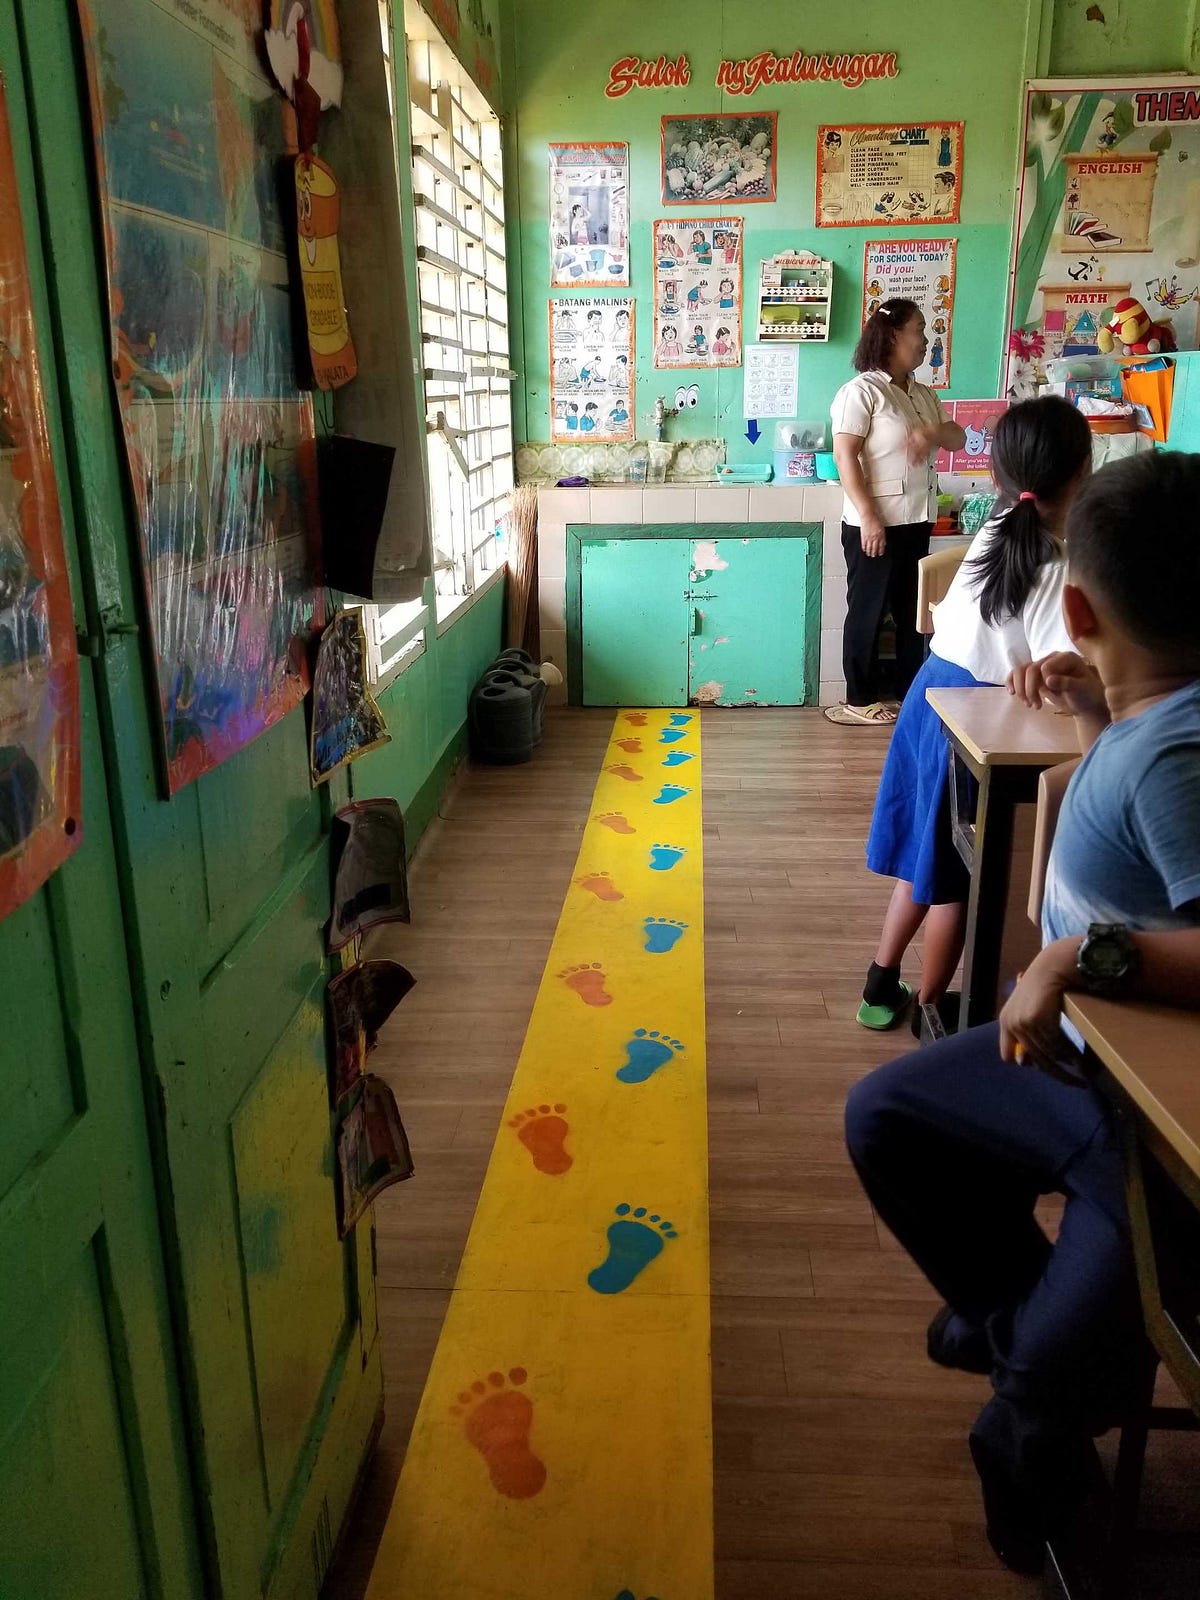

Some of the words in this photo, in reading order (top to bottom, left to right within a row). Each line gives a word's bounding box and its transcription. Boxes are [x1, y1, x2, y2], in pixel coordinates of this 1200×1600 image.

[605, 54, 691, 99] Sulok
[900, 128, 927, 139] CHART
[1078, 163, 1143, 175] ENGLISH
[878, 244, 896, 254] ARE
[898, 243, 916, 254] YOU
[917, 241, 946, 253] READY
[869, 255, 885, 263] FOR
[886, 253, 917, 263] SCHOOL
[919, 253, 949, 262] TODAY?
[876, 264, 892, 274] Did
[894, 265, 915, 276] you:
[559, 299, 591, 307] BATANG
[593, 298, 628, 306] MALINIS
[1065, 294, 1108, 304] MATH
